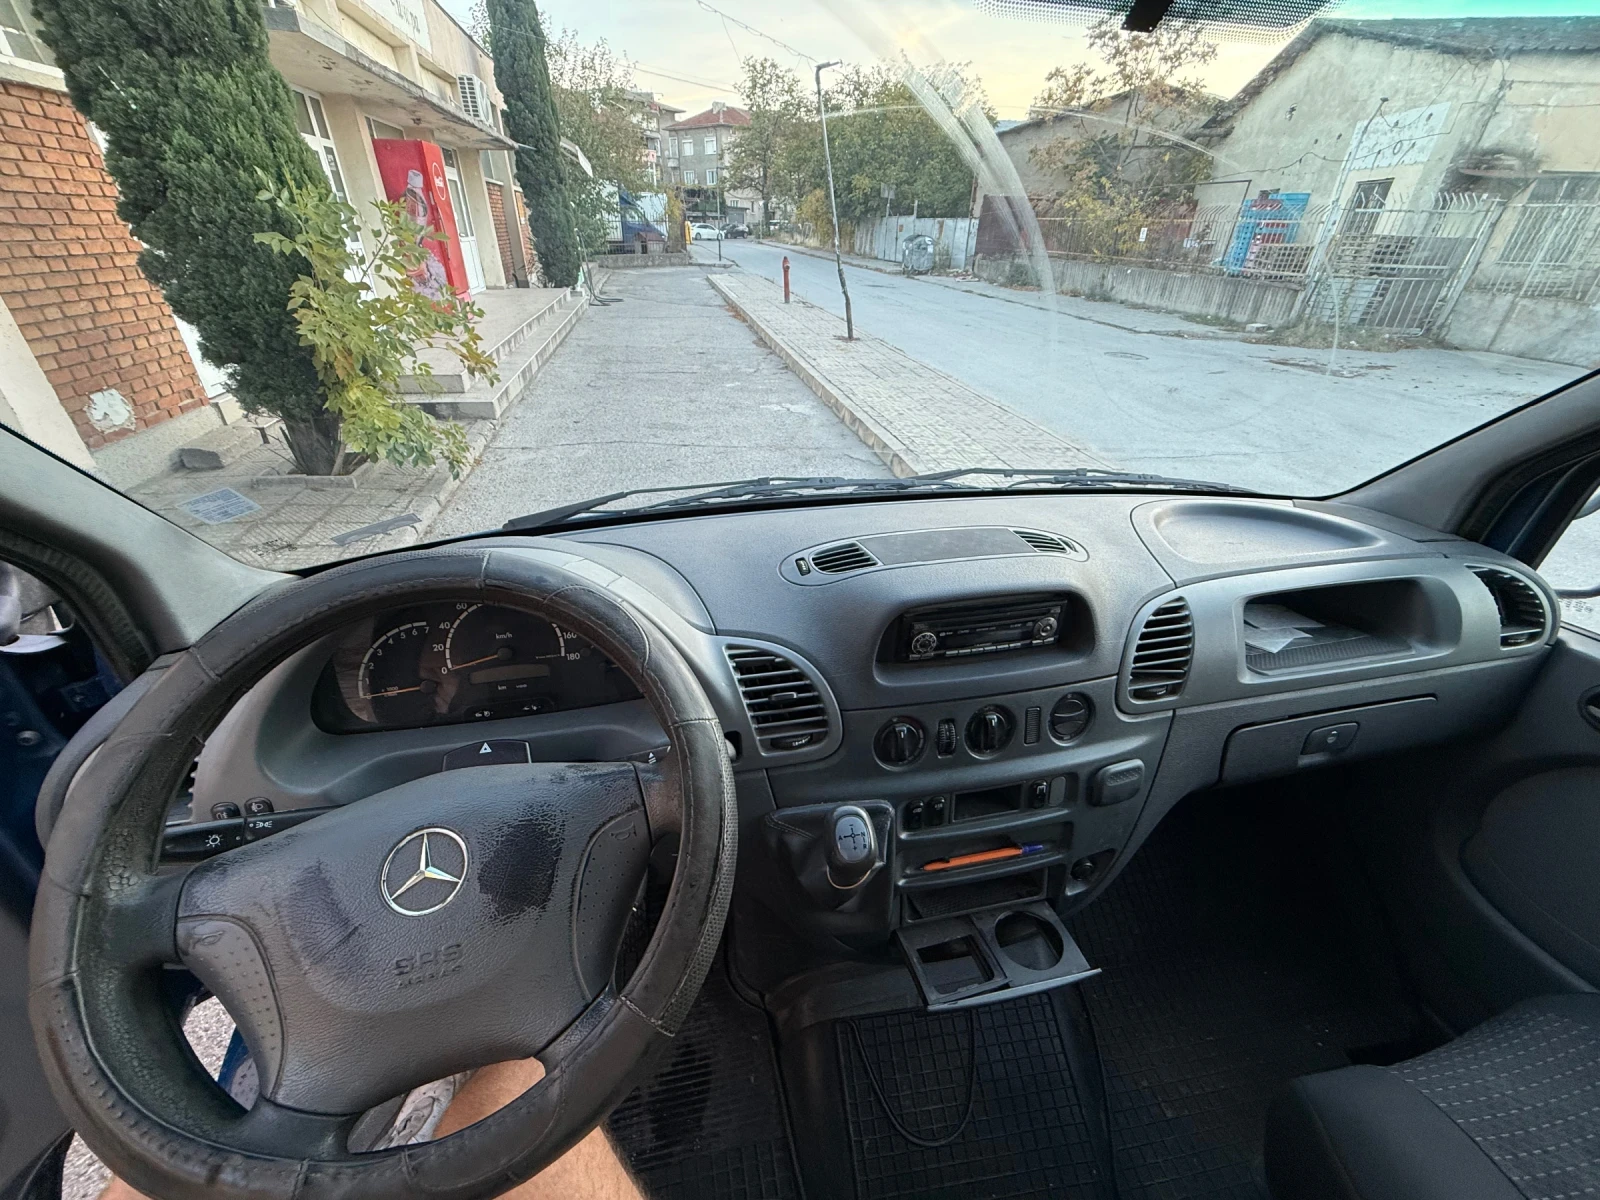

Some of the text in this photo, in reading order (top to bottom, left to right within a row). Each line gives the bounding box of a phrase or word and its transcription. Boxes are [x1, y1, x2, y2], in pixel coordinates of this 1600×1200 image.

[456, 602, 467, 610] 60
[439, 621, 450, 629] 40
[411, 628, 418, 636] 6
[424, 626, 430, 634] 7
[400, 631, 406, 639] 5
[432, 643, 444, 652] 20
[376, 648, 383, 656] 3
[565, 652, 580, 661] 180
[368, 662, 375, 670] 2
[441, 666, 448, 674] 0
